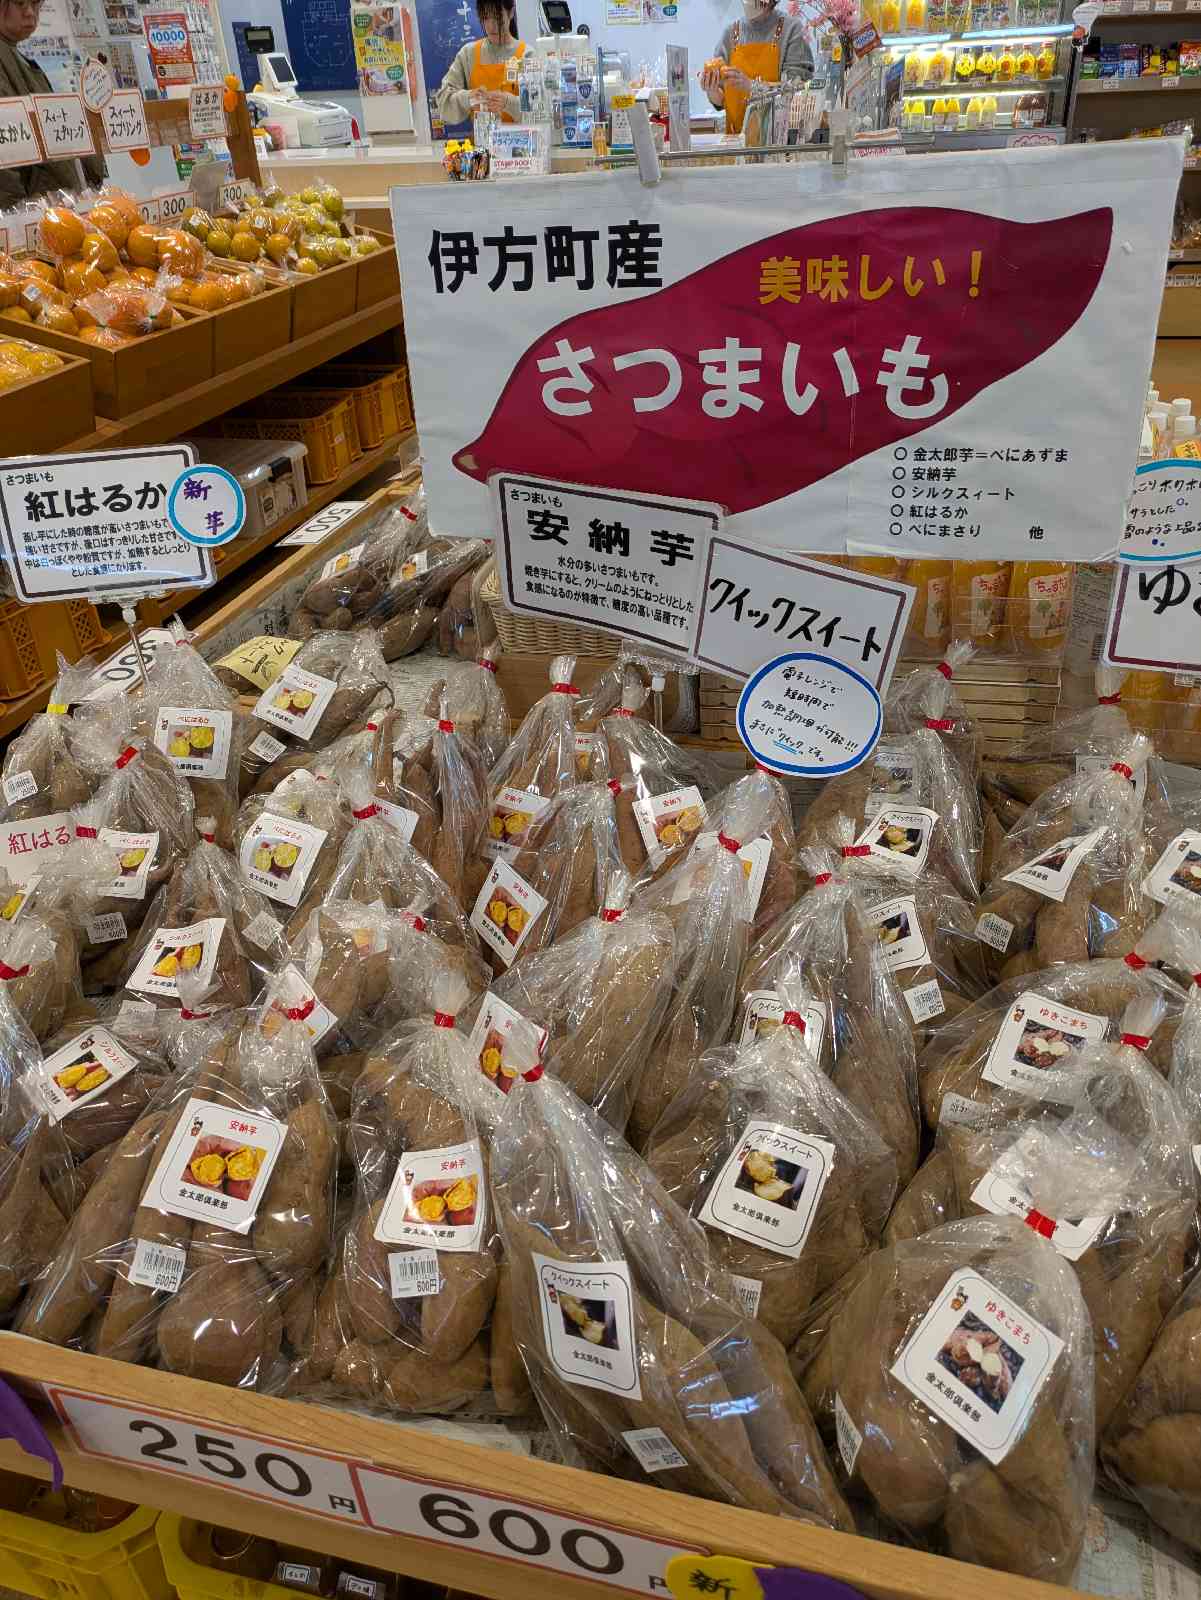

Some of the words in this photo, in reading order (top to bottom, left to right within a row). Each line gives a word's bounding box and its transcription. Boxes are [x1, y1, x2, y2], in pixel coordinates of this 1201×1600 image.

[152, 31, 186, 41] 10000
[195, 94, 219, 105] はるか
[163, 197, 187, 217] 300
[428, 220, 663, 293] 伊方町産
[760, 251, 982, 304] 美味しい！
[537, 334, 948, 419] さつまいも
[6, 471, 54, 485] さつまいも
[912, 467, 957, 481] 安納芋
[23, 481, 167, 522] 紅はるか
[511, 489, 563, 508] さつまいも
[305, 508, 352, 533] 500
[909, 505, 968, 519] 紅はるか
[527, 510, 694, 567] 安納芋
[908, 523, 981, 537] べにまさり
[1029, 526, 1044, 540] 他
[557, 556, 659, 587] 水分の多いさつまいもです。
[709, 578, 882, 661] クイックスイート
[1039, 1007, 1089, 1031] ゆきこまち
[227, 1119, 258, 1135] 安納芋
[440, 1157, 466, 1172] 安納芋
[550, 1271, 610, 1290] クイックスイート
[984, 1300, 1032, 1346] ゆきこまち
[129, 1420, 313, 1497] 250
[328, 1494, 357, 1514] 円
[418, 1493, 624, 1575] 600
